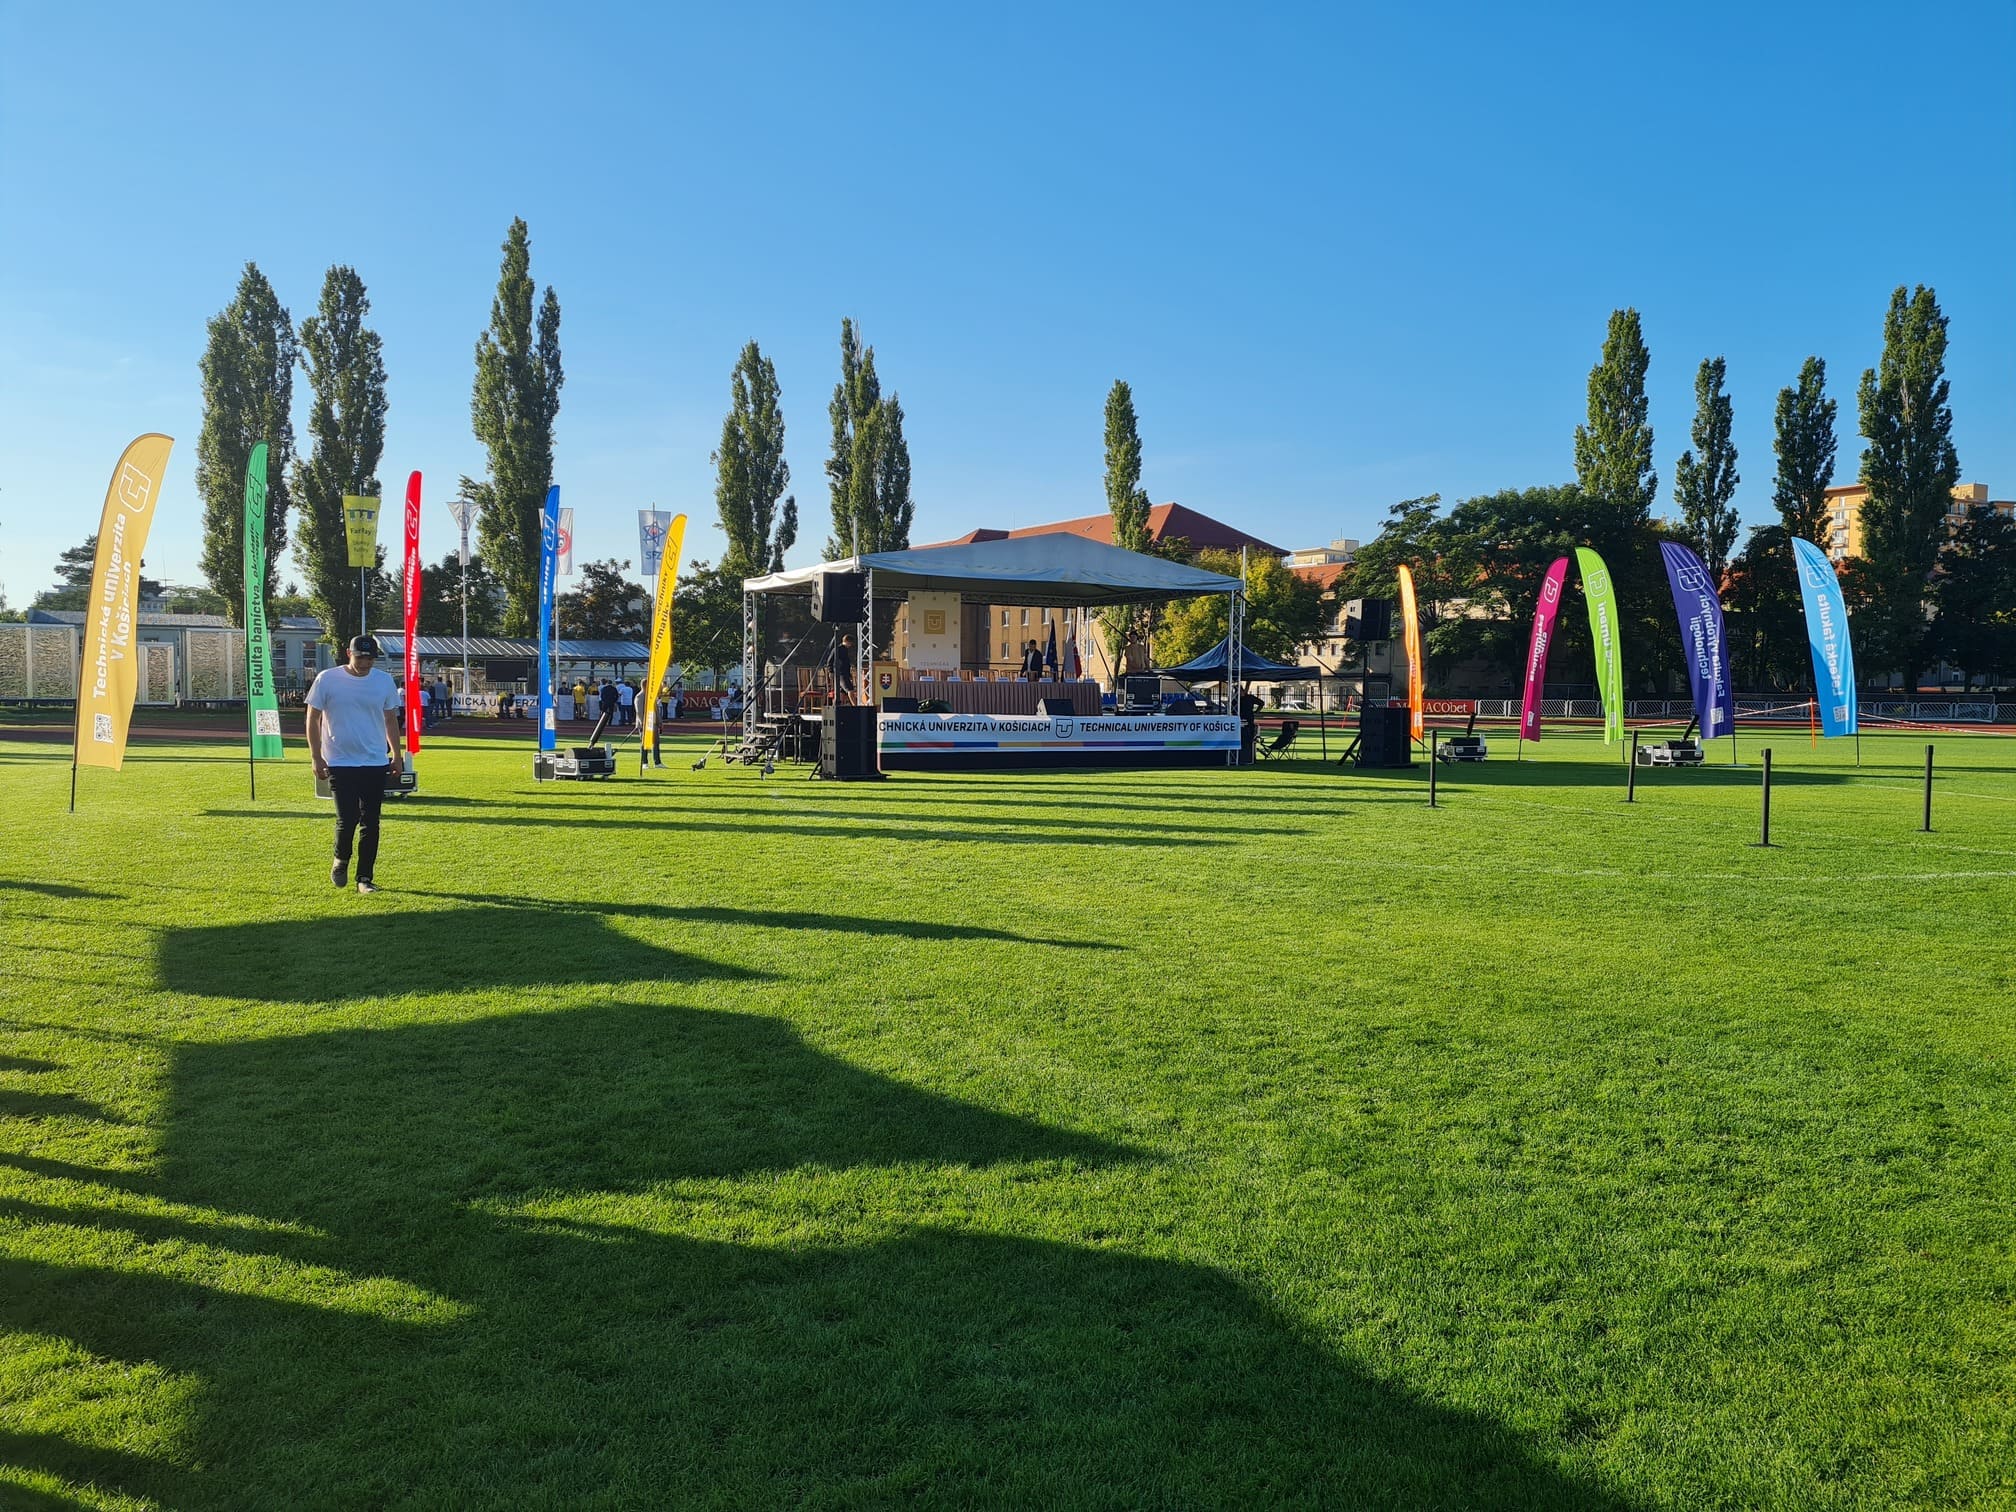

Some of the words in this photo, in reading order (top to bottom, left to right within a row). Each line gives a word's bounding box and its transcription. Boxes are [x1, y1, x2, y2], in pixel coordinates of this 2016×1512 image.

[102, 512, 127, 602] univerzita
[93, 605, 112, 699] Technická
[250, 646, 264, 697] Fakulta
[928, 721, 988, 732] UNIVERZITA
[990, 721, 997, 732] V
[1000, 720, 1051, 732] KOŠICIACH
[1080, 722, 1132, 732] TECHNICAL
[1134, 722, 1189, 732] UNIVERSITY
[1189, 722, 1201, 731] OF
[1203, 720, 1236, 732] KOŠICE
